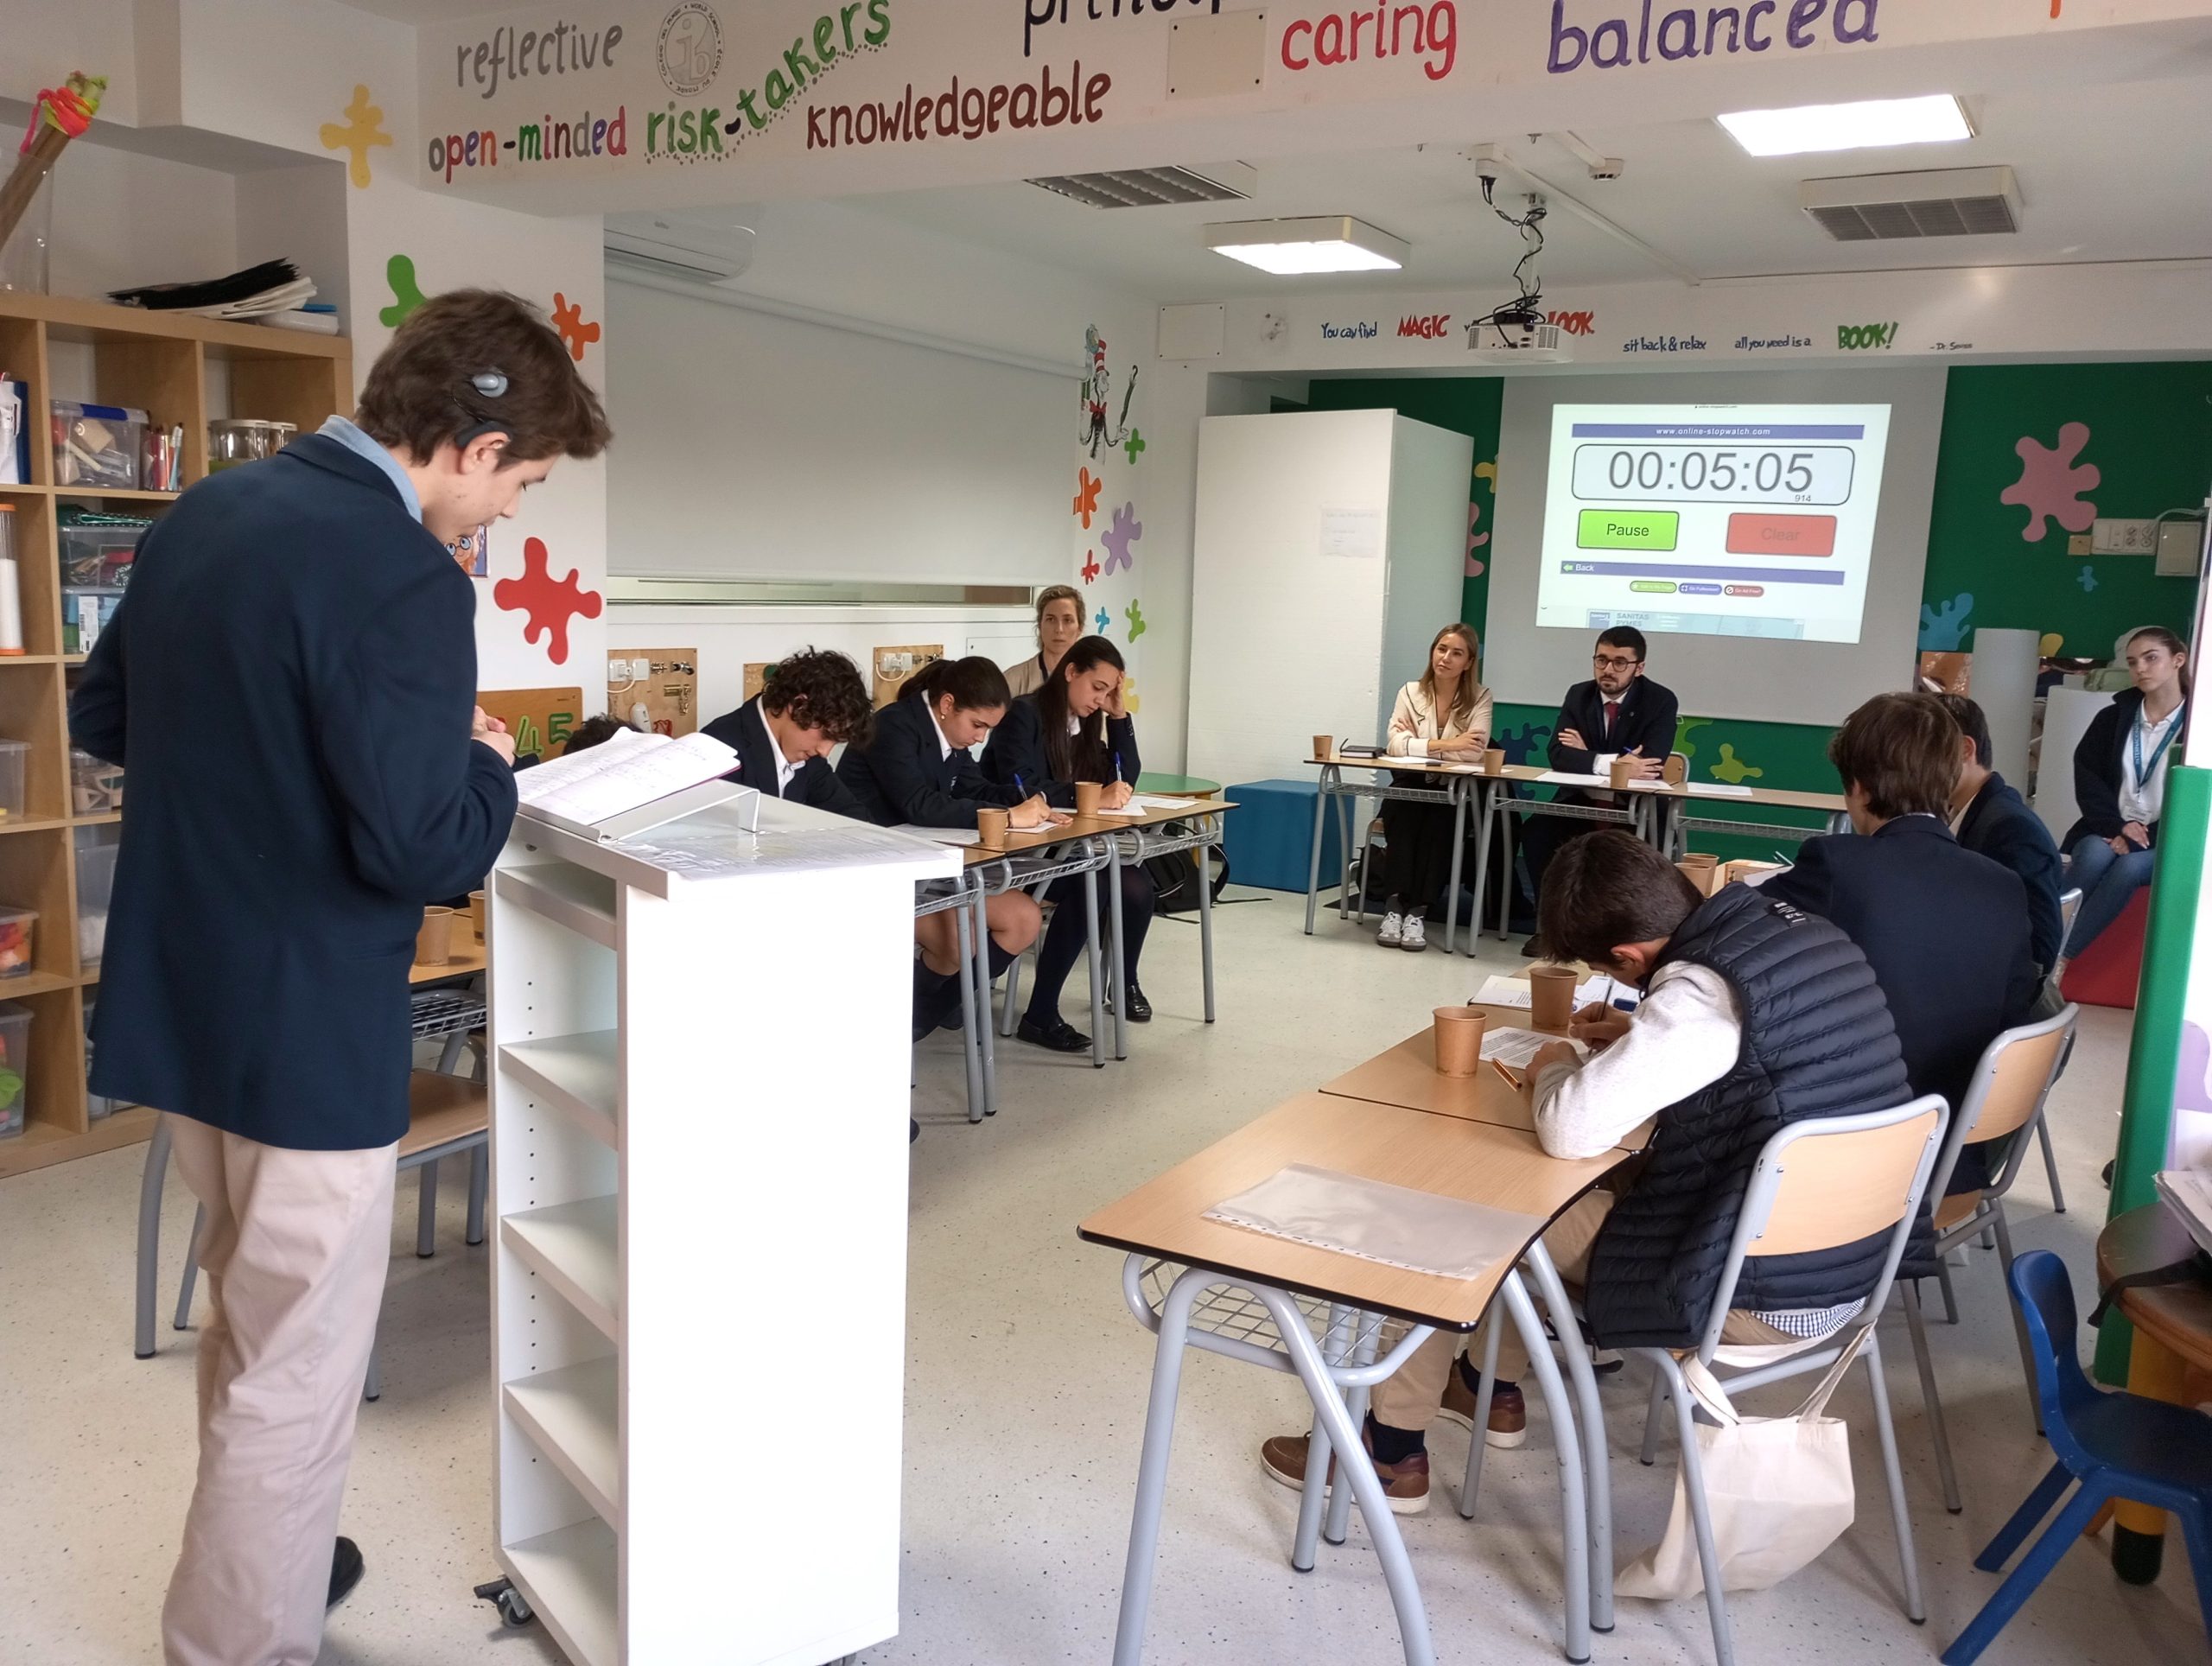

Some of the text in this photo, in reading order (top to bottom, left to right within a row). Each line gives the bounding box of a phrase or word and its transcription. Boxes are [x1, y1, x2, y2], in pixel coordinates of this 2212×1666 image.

[1281, 0, 1458, 80] caring
[1547, 0, 1879, 74] balanced
[457, 19, 623, 99] reflective
[647, 0, 891, 155] risk-takers
[806, 59, 1112, 149] knowledgeable
[1321, 322, 1339, 338] You
[1340, 327, 1357, 339] can
[1358, 321, 1377, 339] find
[1396, 315, 1451, 339] MAGIC
[1734, 321, 1898, 351] all you need is a BOOK!
[1623, 334, 1707, 353] sit back & relax
[1656, 427, 1770, 436] www.online-stopwatch.com
[1608, 450, 1814, 493] 00:05:05
[1794, 494, 1812, 503] 914
[1605, 523, 1650, 537] Pause
[1761, 527, 1800, 542] Clear
[1574, 563, 1595, 572] Back
[1616, 612, 1649, 620] SANITAS
